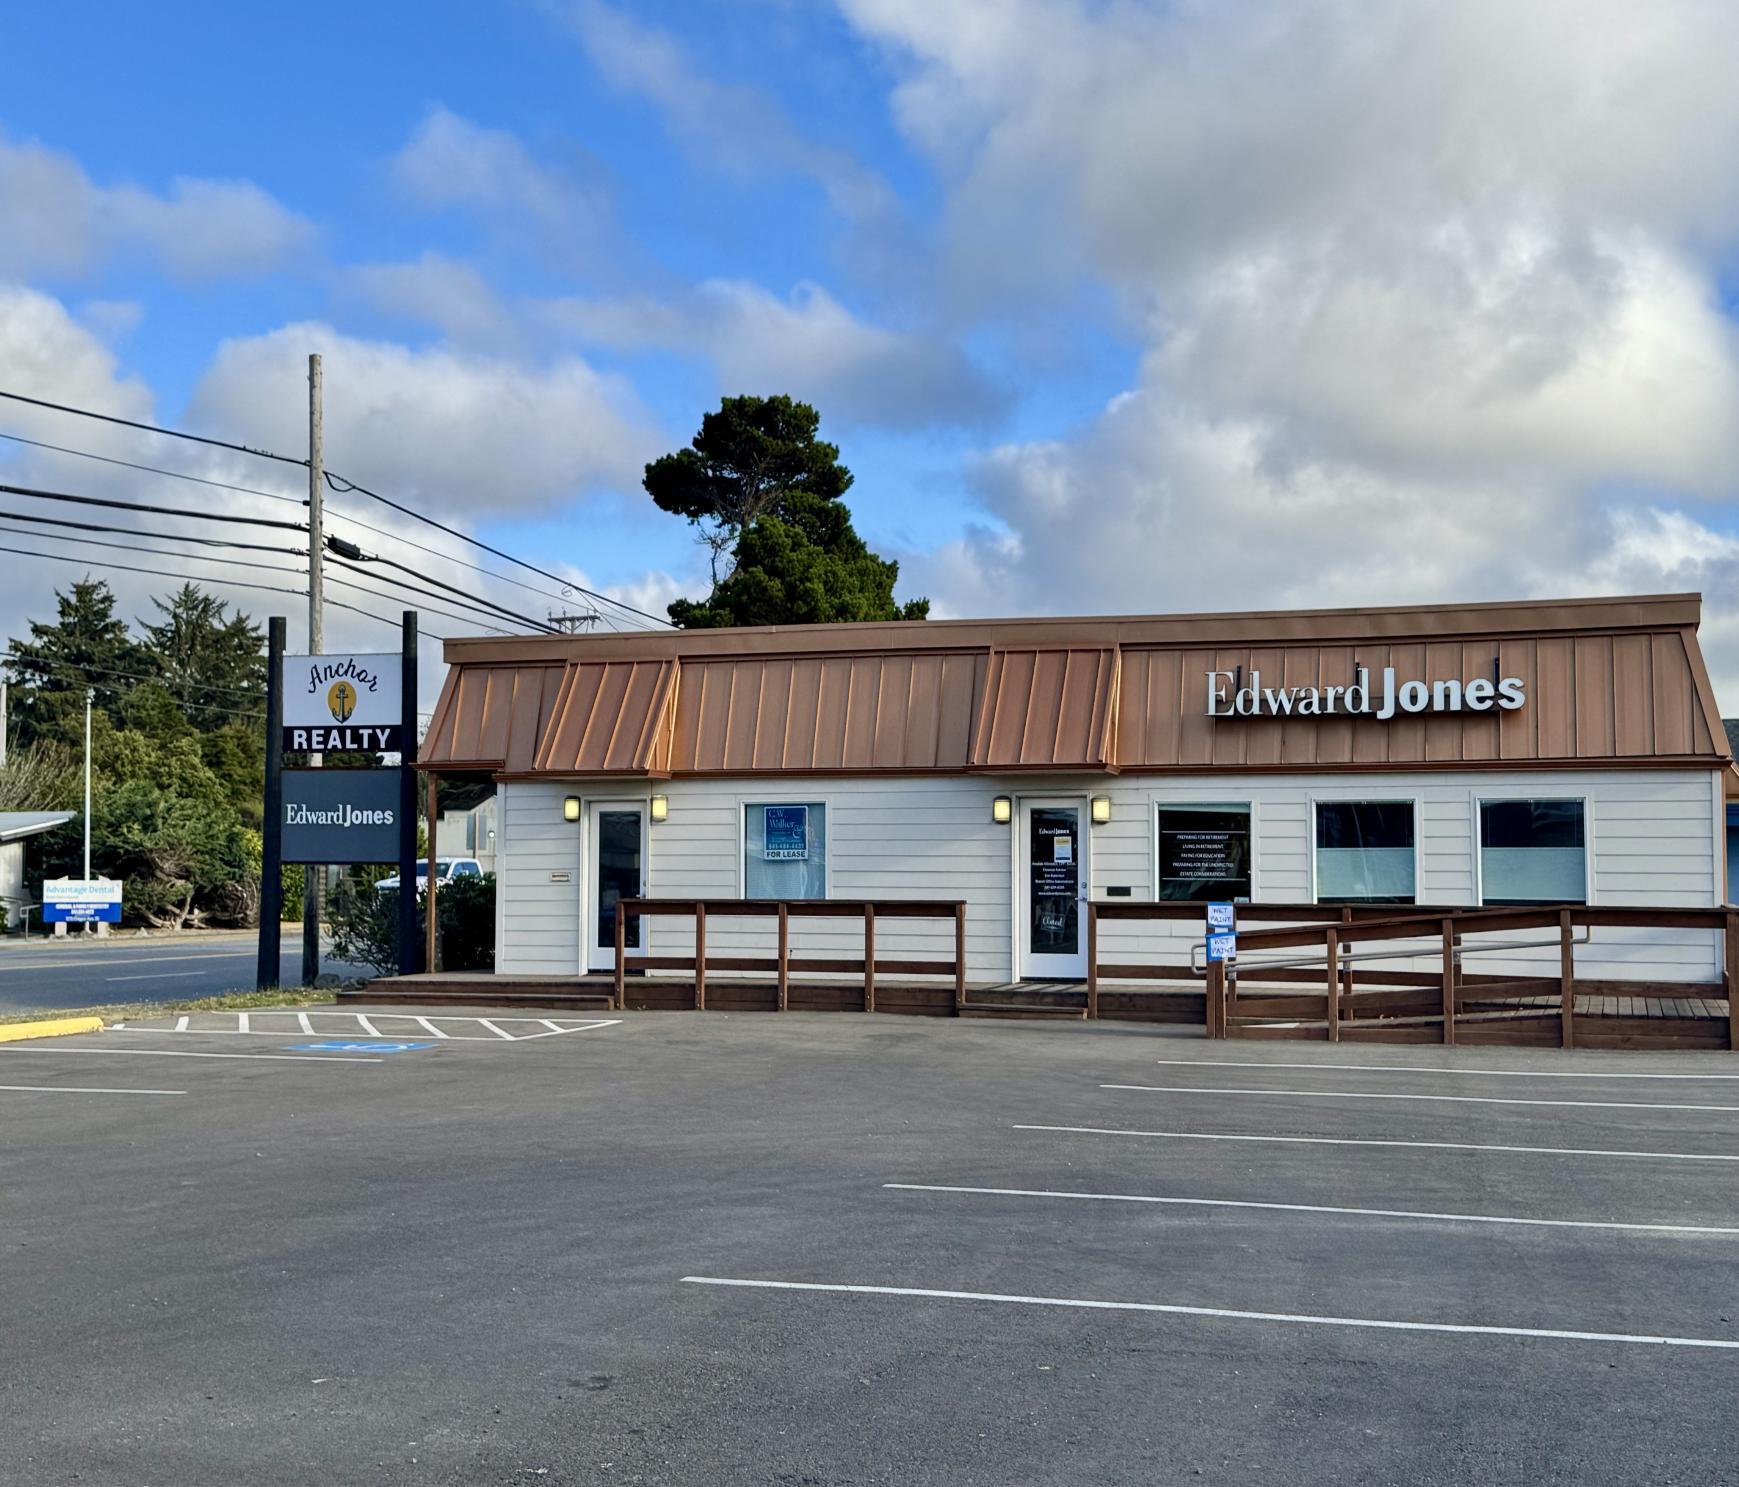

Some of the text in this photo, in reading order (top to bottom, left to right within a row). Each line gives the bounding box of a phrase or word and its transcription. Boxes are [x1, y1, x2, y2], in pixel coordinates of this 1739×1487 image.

[308, 658, 378, 693] Anchor
[293, 728, 391, 749] REALTY
[783, 850, 806, 858] LEASE
[1211, 947, 1234, 955] PAINT
